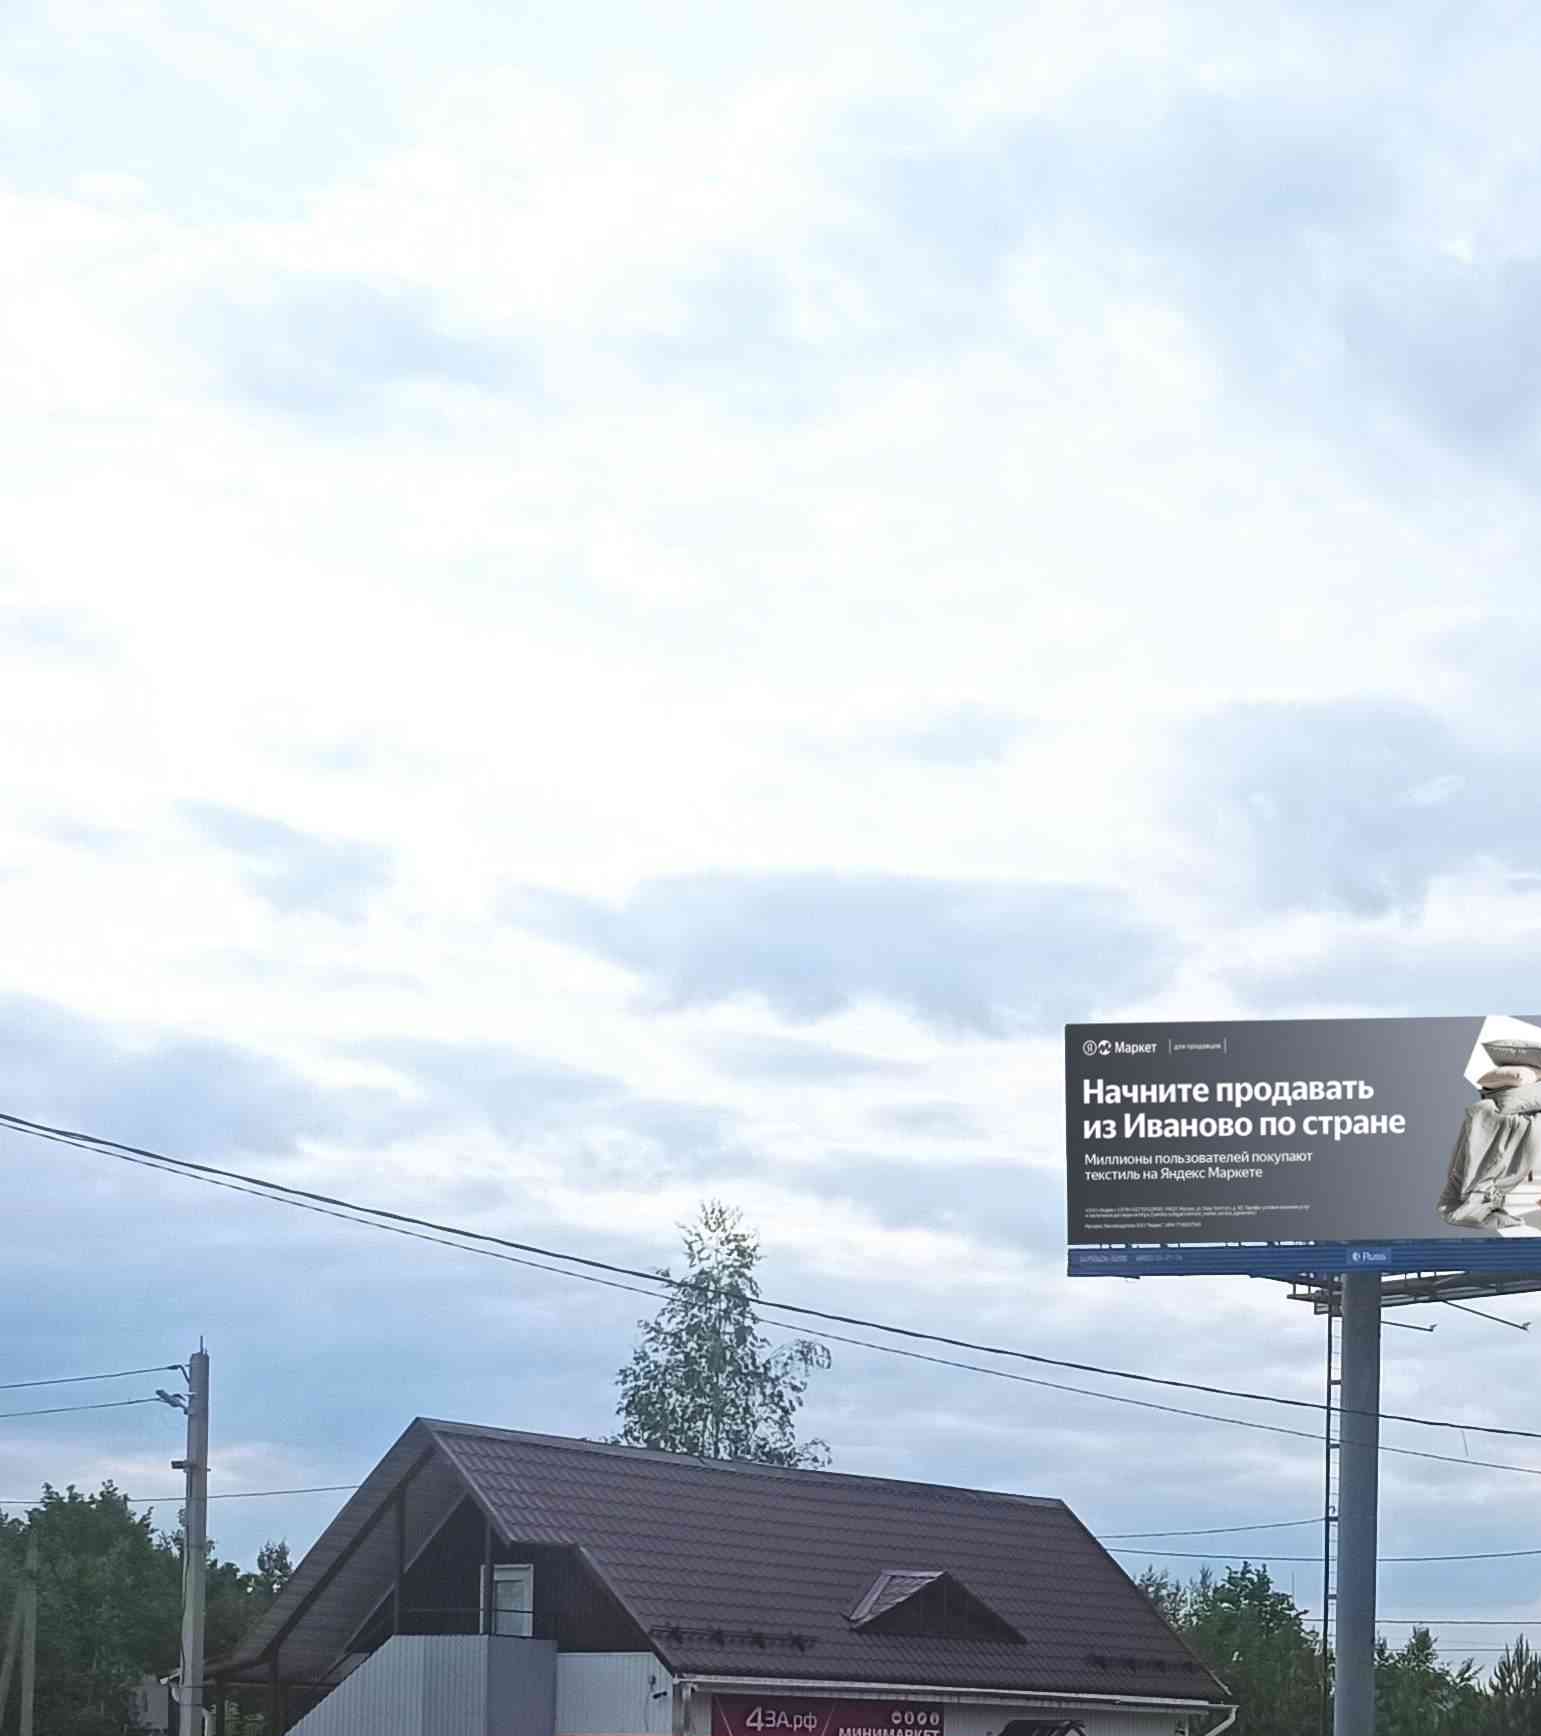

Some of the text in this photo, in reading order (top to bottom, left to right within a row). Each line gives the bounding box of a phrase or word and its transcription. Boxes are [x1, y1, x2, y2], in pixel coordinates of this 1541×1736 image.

[1113, 1041, 1158, 1055] Маркет
[1082, 1078, 1375, 1108] Начните продавать
[1083, 1112, 1406, 1141] из Иваново по стране
[1084, 1151, 1313, 1166] Миллионы пользователей покупают
[1085, 1167, 1263, 1181] текстиль на Яндекс Маркете
